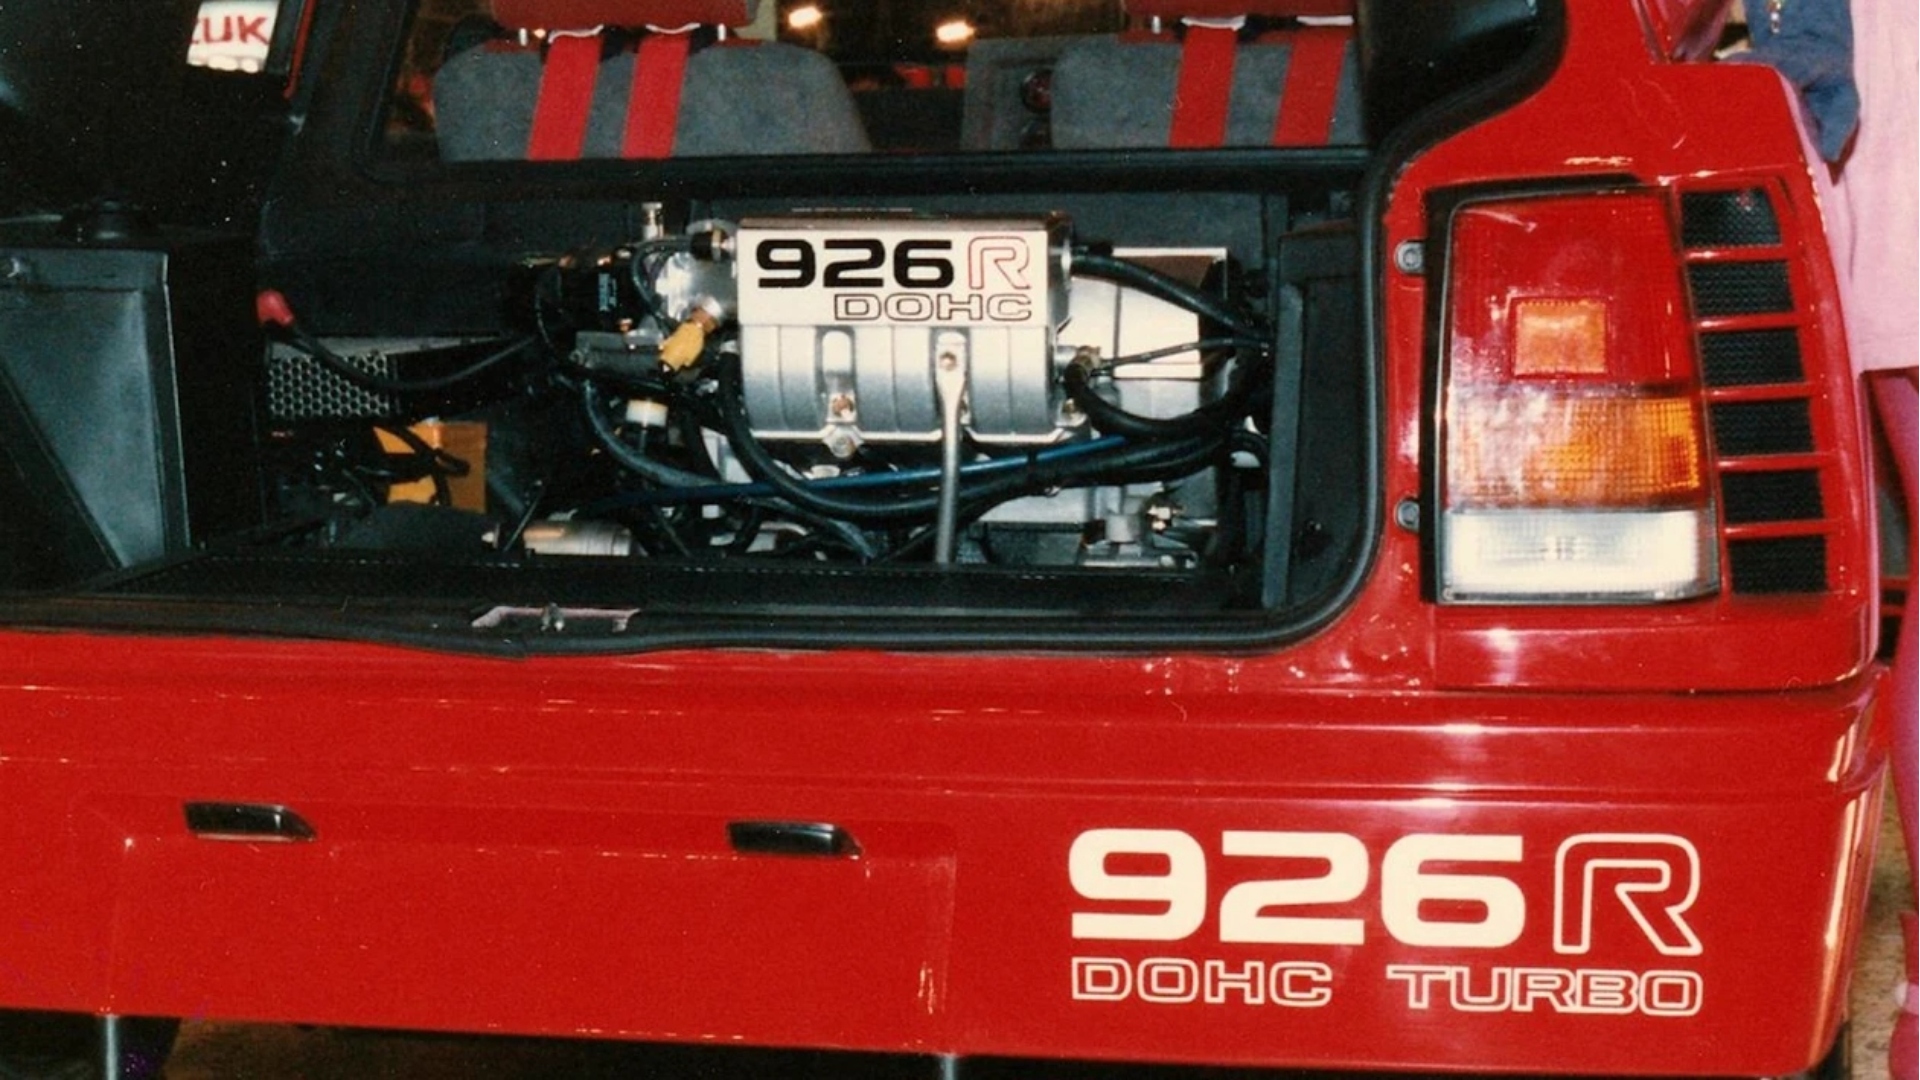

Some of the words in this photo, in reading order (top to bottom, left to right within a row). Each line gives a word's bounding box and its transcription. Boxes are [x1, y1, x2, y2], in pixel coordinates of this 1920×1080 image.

[833, 293, 1032, 321] DOHC
[1071, 957, 1333, 1007] DOHC
[1386, 965, 1703, 1016] TURBO
